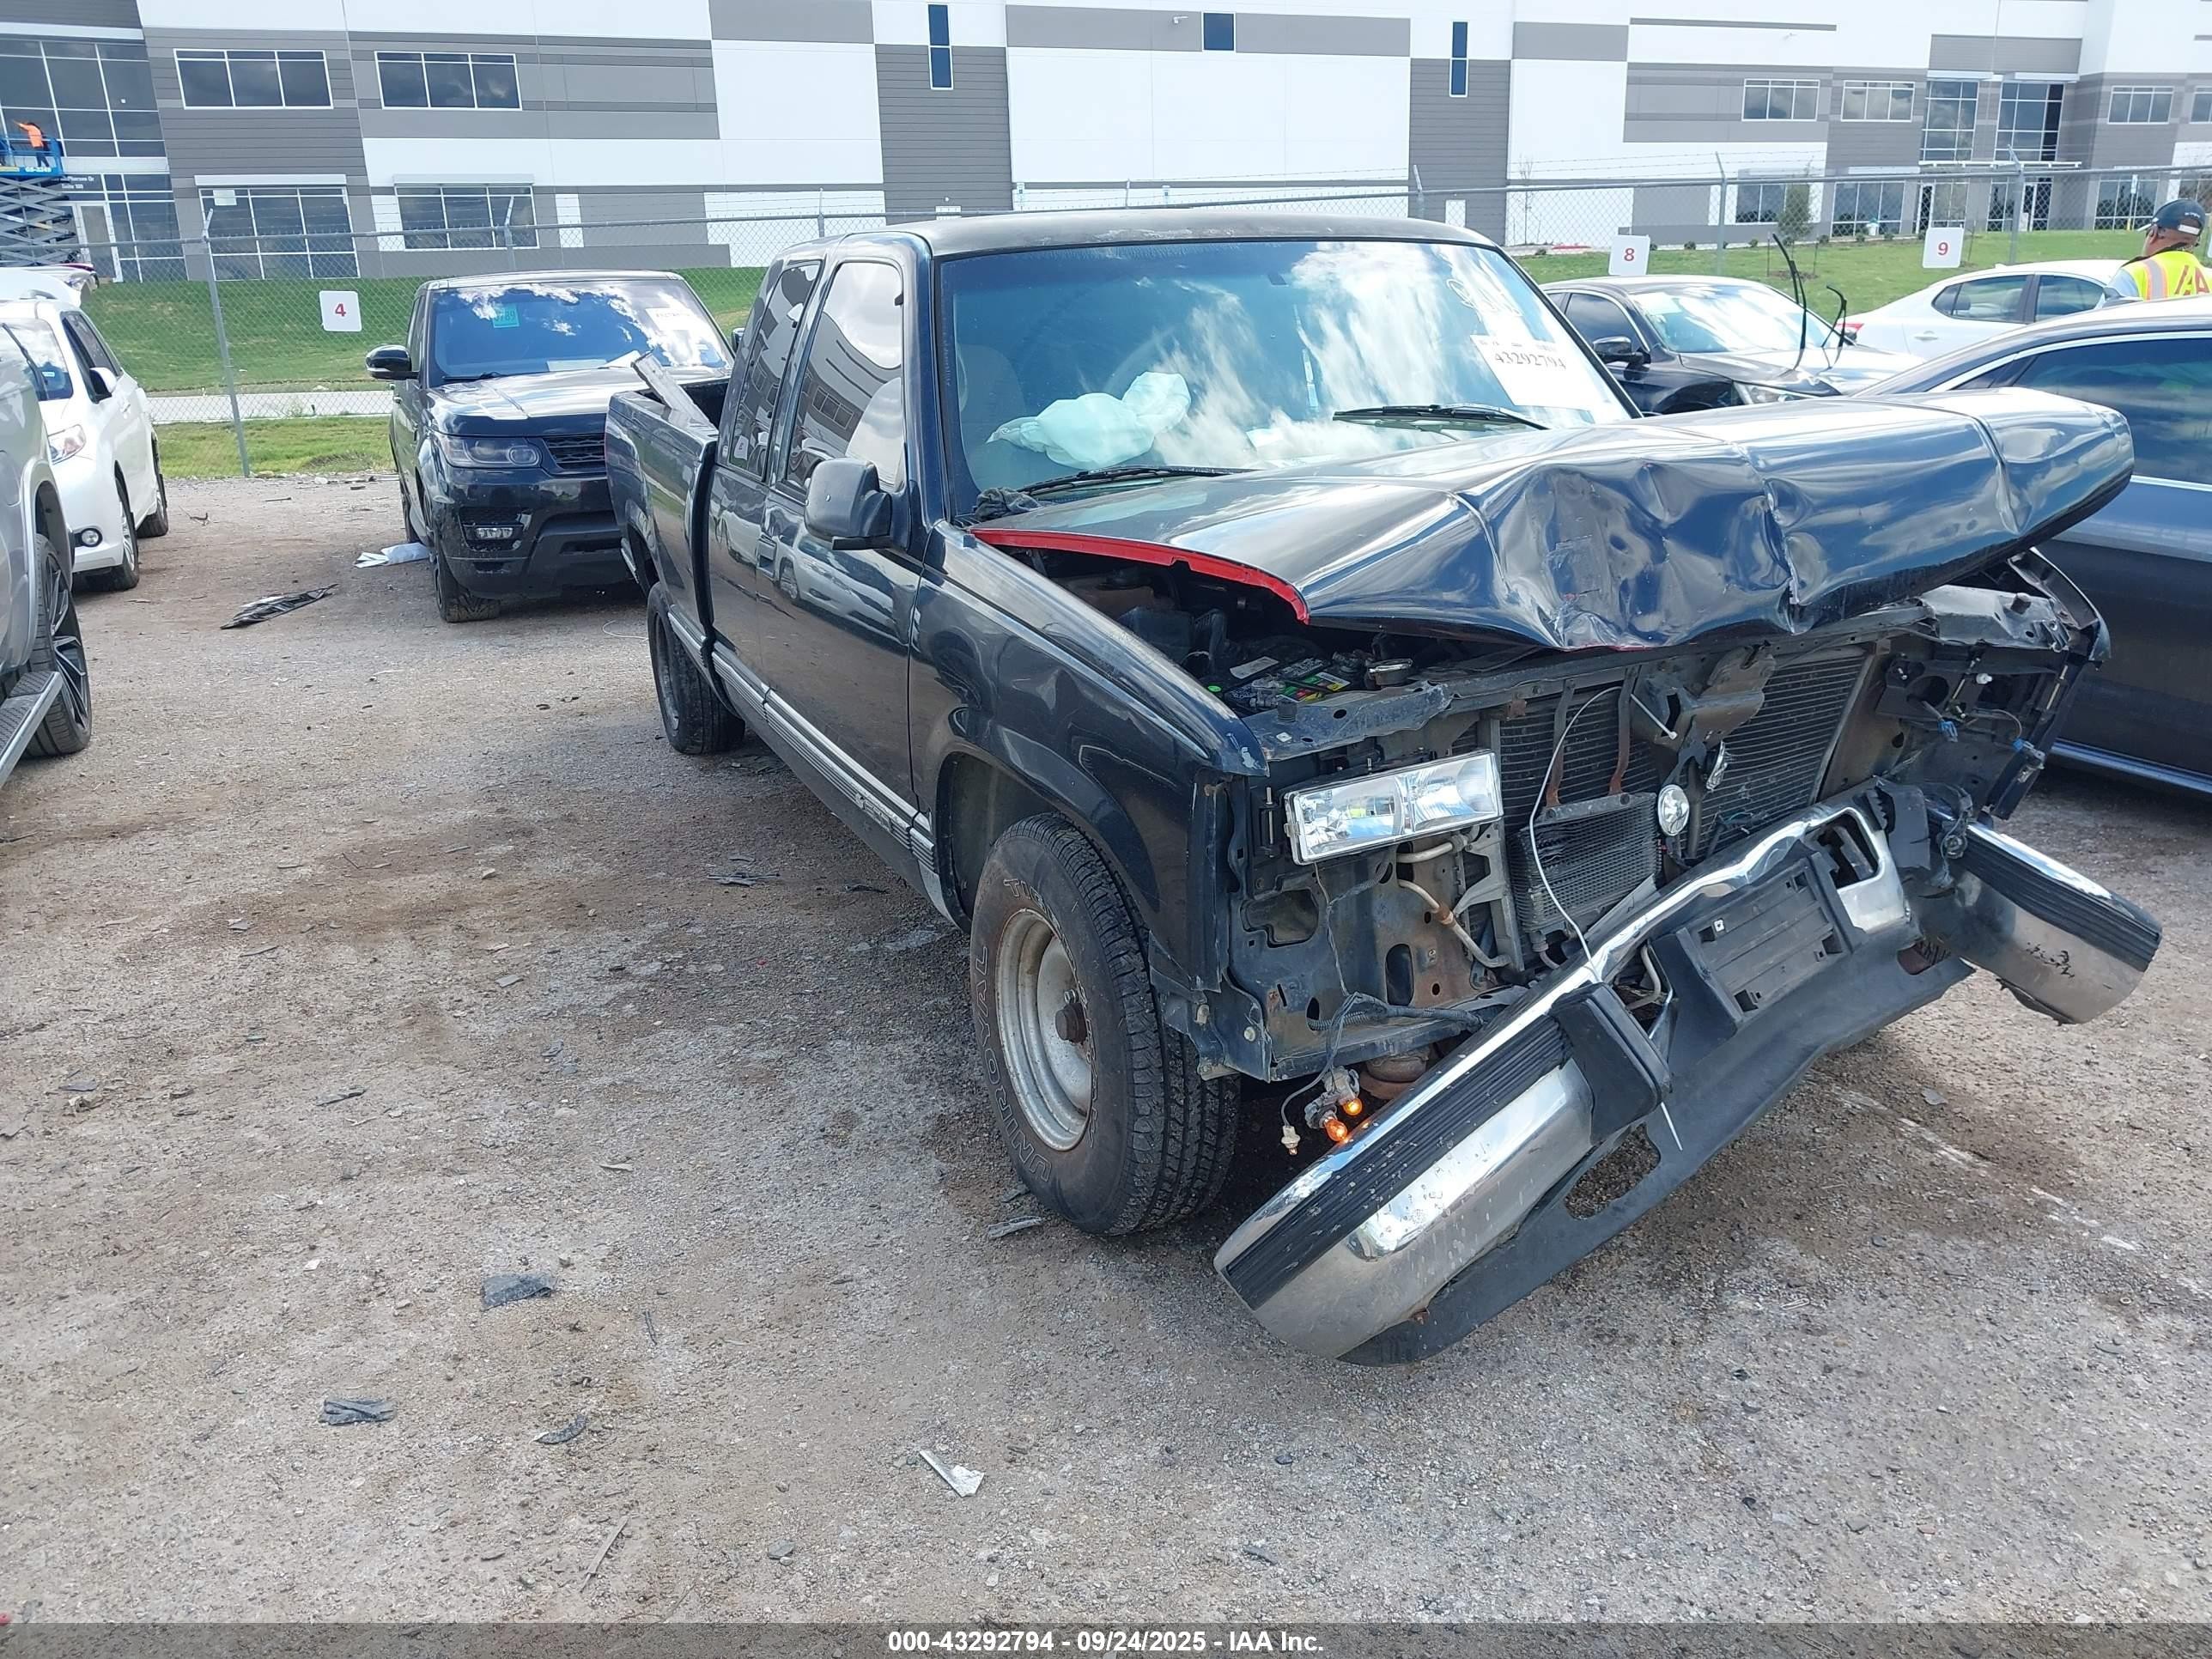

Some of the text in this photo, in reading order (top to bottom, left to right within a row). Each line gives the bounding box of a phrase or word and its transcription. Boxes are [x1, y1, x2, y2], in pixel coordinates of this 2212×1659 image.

[1624, 247, 1635, 262] 8
[1937, 241, 1949, 256] 9
[335, 303, 347, 317] 4
[975, 945, 1052, 1182] UNIROYAL
